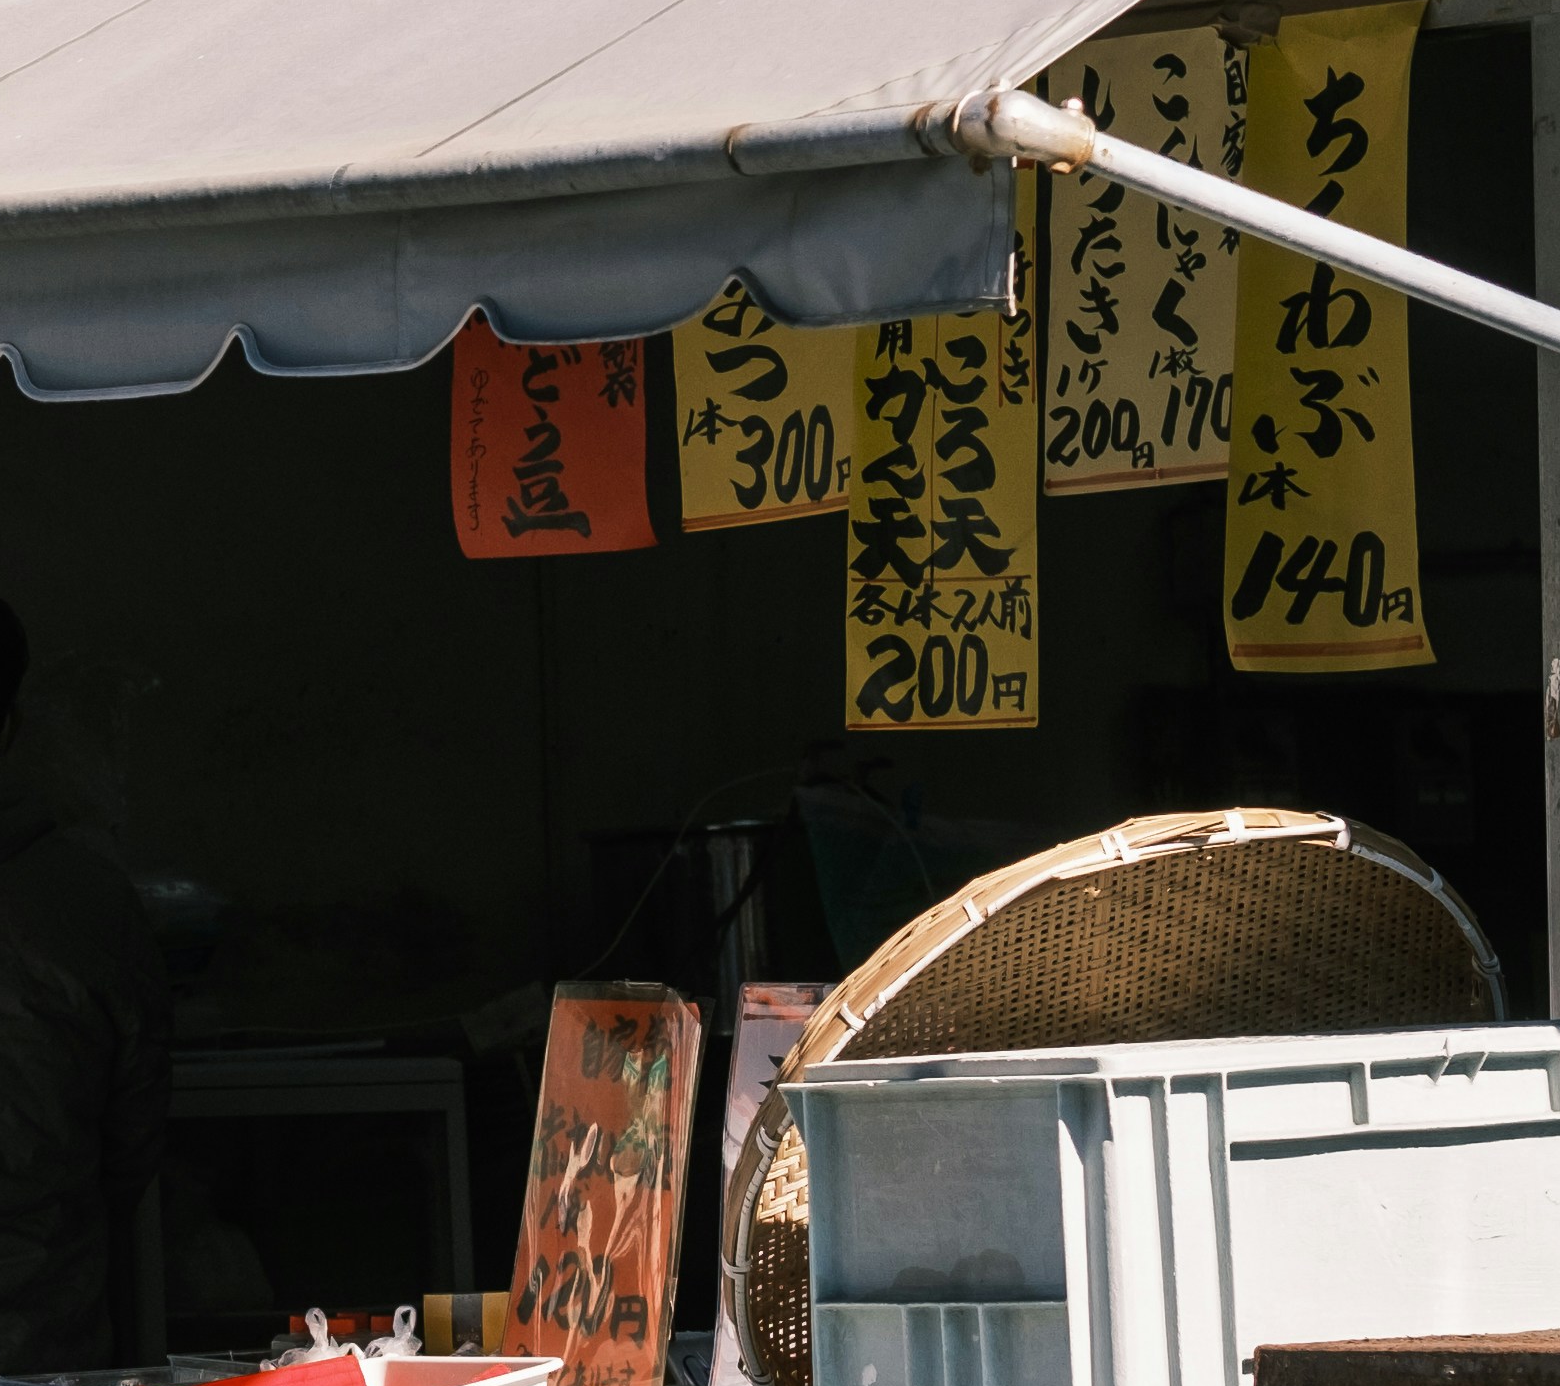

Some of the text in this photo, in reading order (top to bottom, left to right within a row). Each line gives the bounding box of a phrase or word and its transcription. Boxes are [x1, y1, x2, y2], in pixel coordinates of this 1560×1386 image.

[499, 340, 592, 539] どう豆
[930, 311, 1017, 577] ころ天
[1045, 397, 1154, 469] 200円
[1232, 530, 1414, 627] 140円
[856, 633, 1028, 723] 200円
